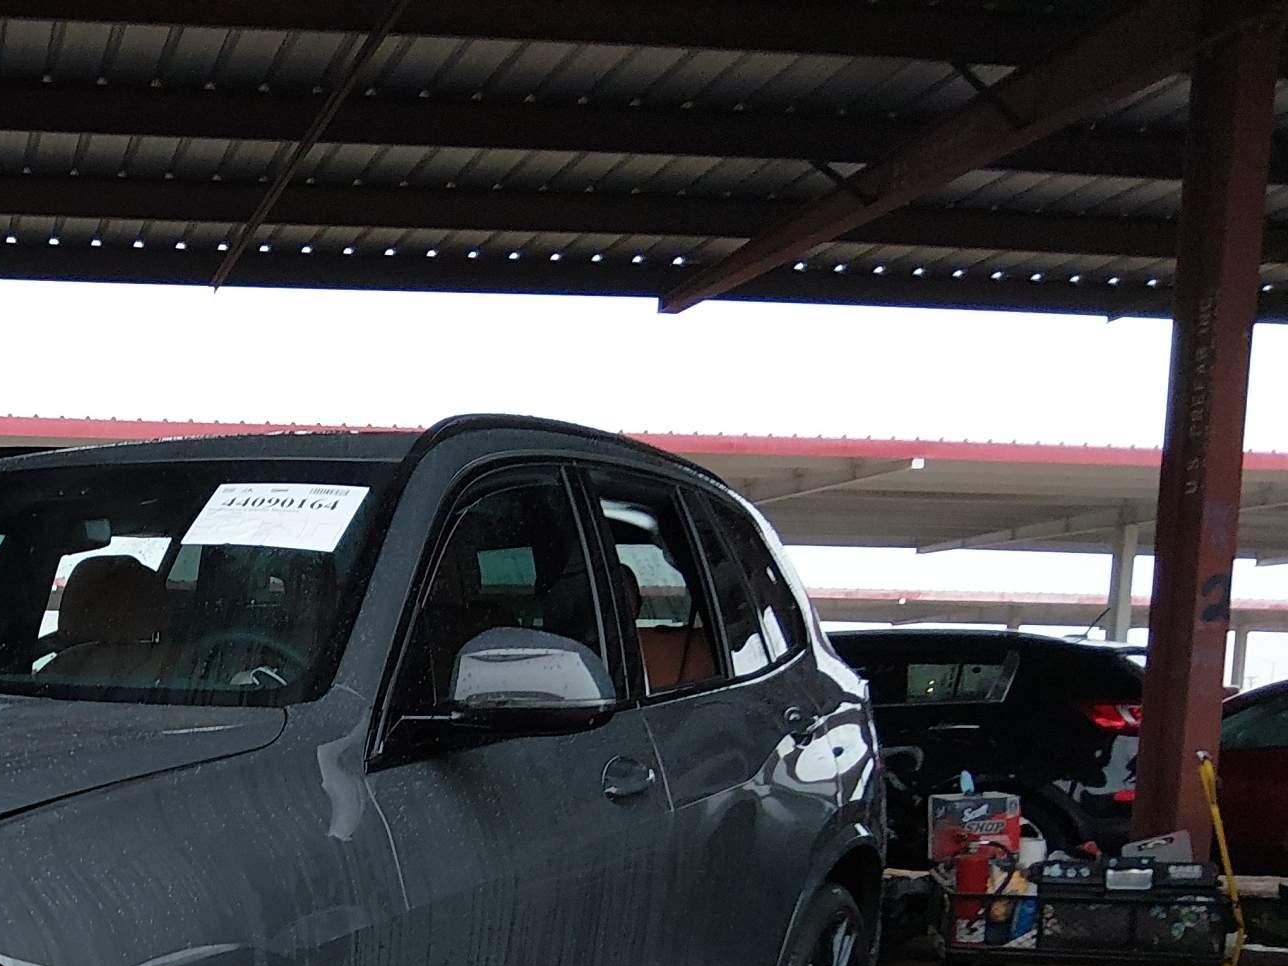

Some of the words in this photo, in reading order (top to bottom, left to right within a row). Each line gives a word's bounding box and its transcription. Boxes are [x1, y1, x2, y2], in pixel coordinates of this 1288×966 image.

[221, 495, 340, 511] 44090164
[1201, 573, 1229, 624] 2
[966, 820, 1005, 833] SHOP
